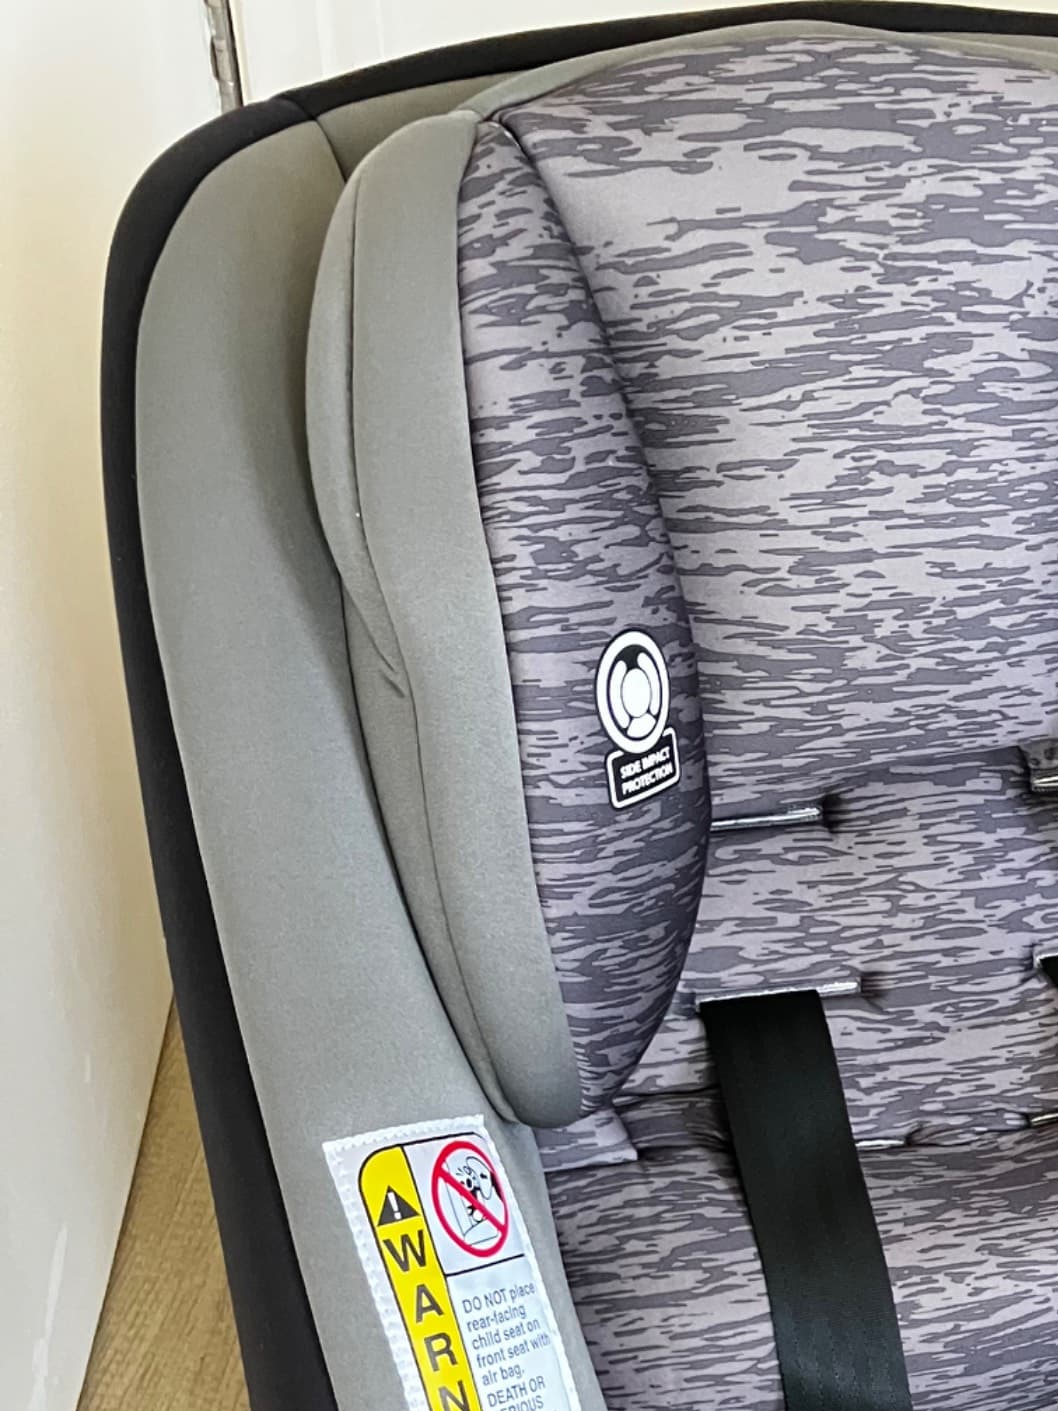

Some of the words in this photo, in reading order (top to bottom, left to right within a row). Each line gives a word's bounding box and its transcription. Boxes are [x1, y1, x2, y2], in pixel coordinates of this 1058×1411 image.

[620, 760, 642, 779] SIDE
[641, 746, 671, 772] IMPACT
[621, 762, 673, 795] PROTECTION
[462, 1296, 482, 1314] DO
[484, 1288, 508, 1307] NOT
[509, 1282, 536, 1301] place
[466, 1305, 526, 1332] rear-facing
[472, 1331, 501, 1350] child
[503, 1323, 525, 1341] seat
[527, 1319, 541, 1333] on
[476, 1350, 507, 1368] front
[507, 1342, 530, 1359] seat
[530, 1333, 551, 1350] with
[482, 1372, 498, 1386] air
[499, 1364, 525, 1383] bag.
[487, 1384, 528, 1407] DEATH
[529, 1375, 546, 1393] OR
